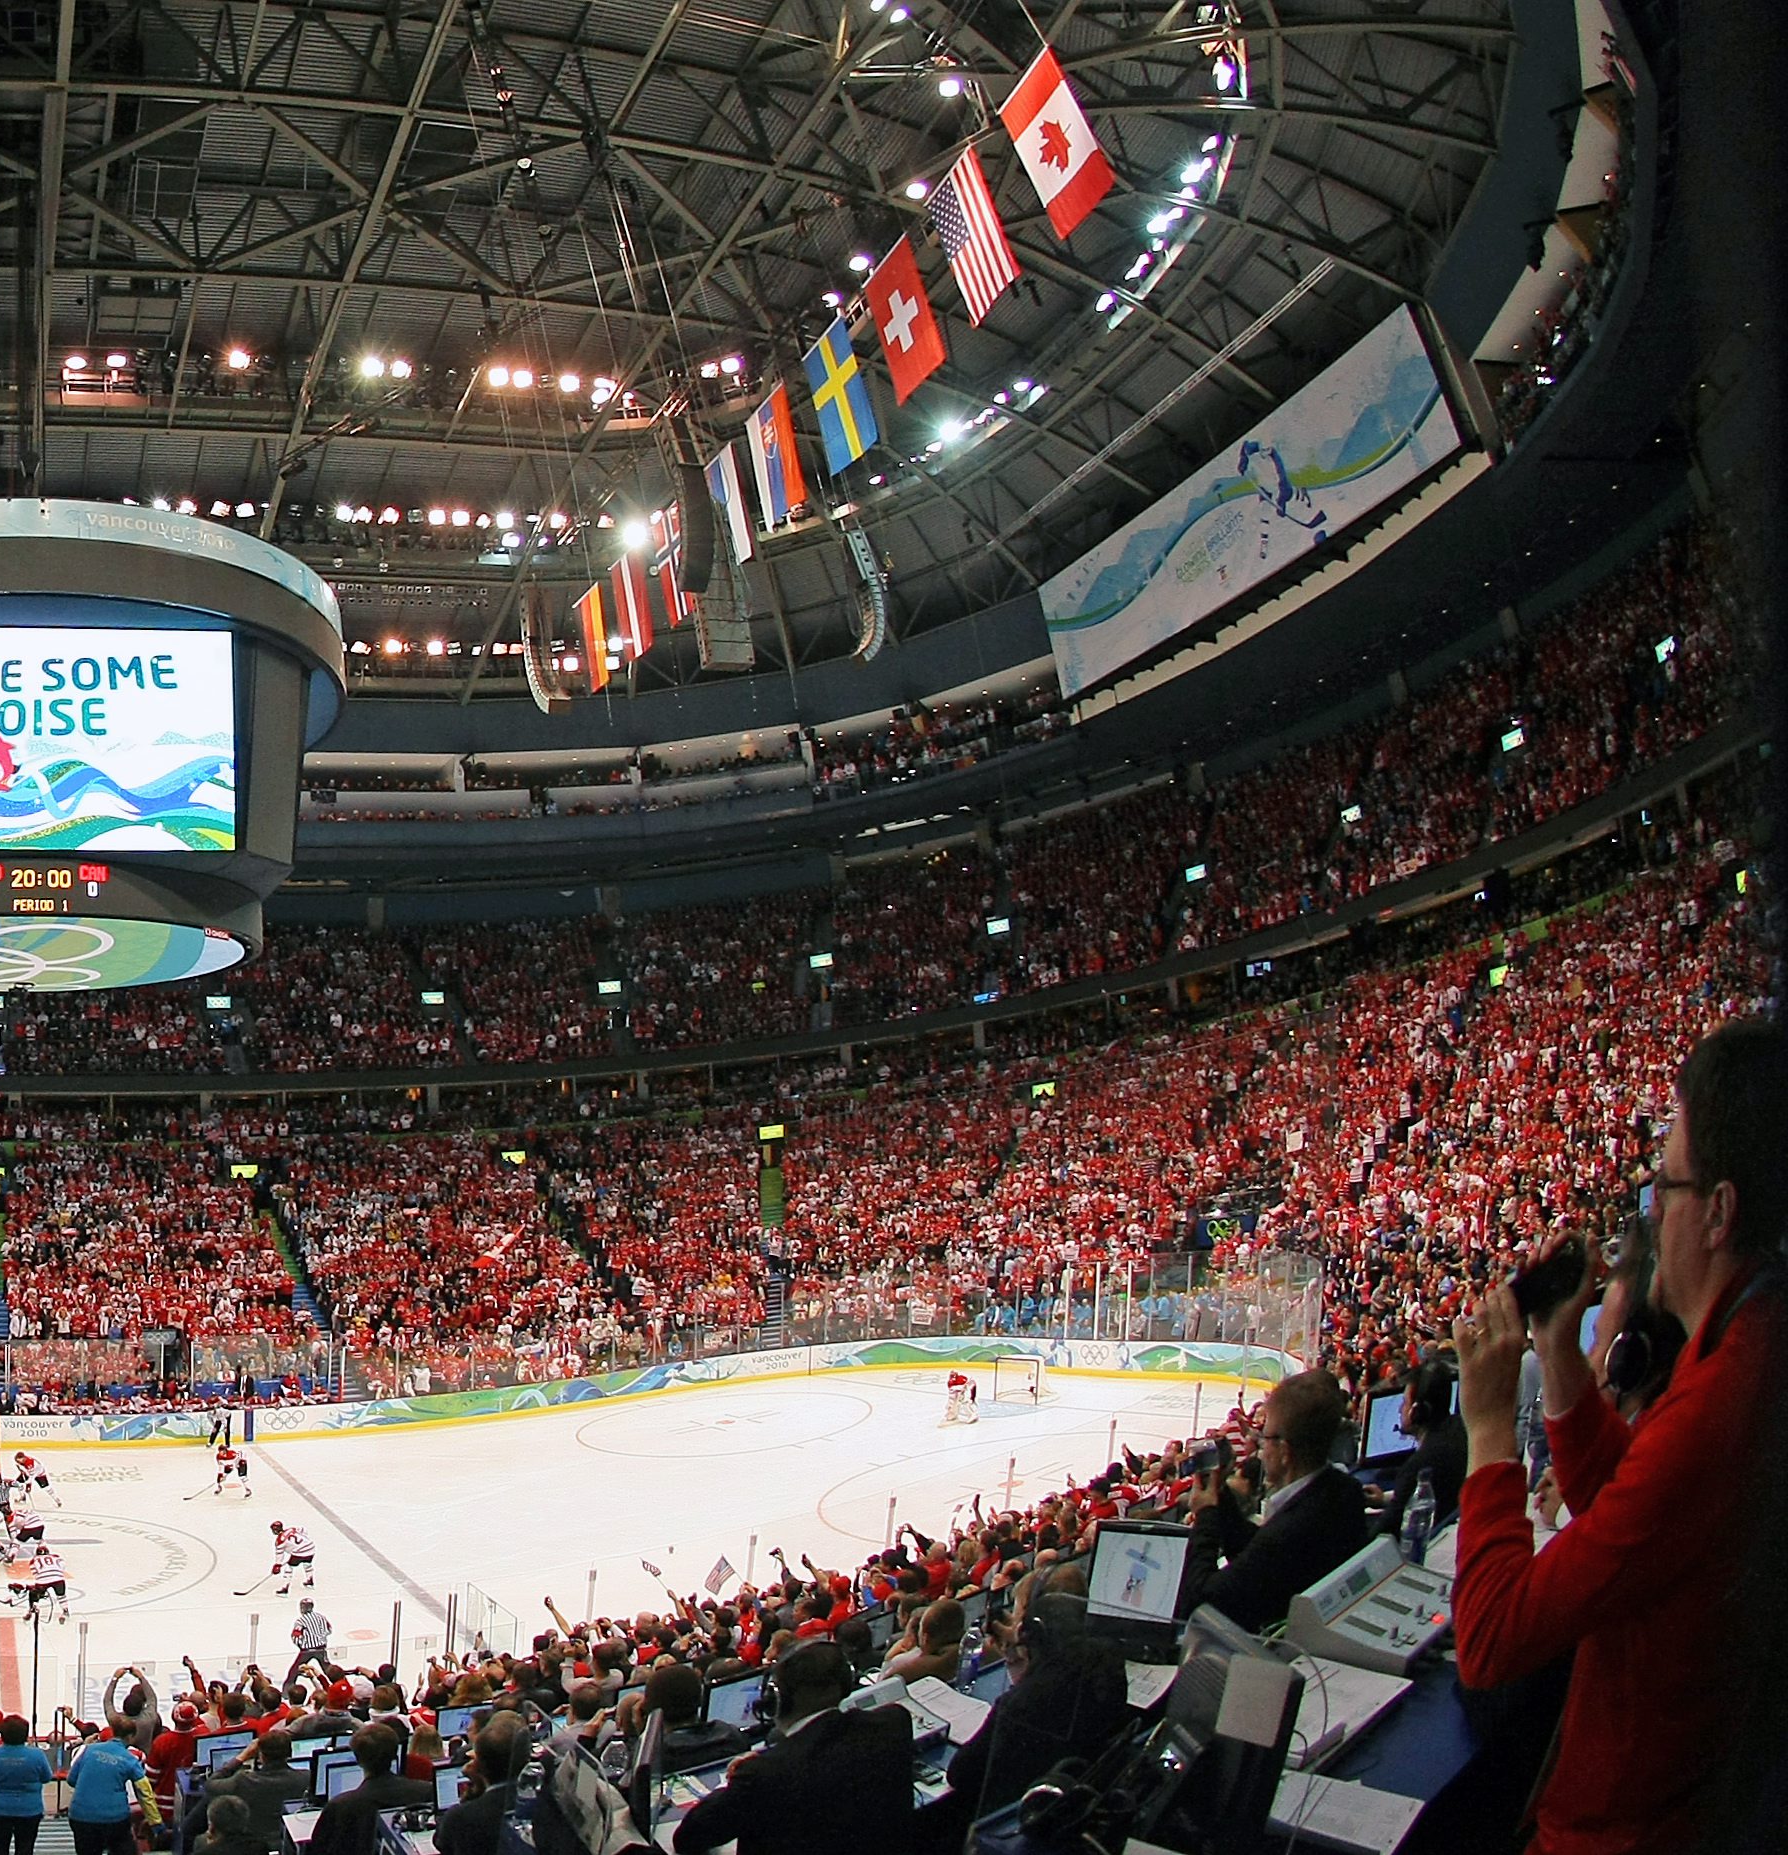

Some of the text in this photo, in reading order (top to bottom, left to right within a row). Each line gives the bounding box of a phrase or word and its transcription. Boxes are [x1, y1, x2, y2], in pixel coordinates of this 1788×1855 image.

[86, 512, 189, 538] vancouver
[41, 655, 178, 691] SOME
[11, 869, 72, 888] 20:00
[79, 864, 107, 881] CAN
[86, 881, 99, 897] 0
[13, 899, 68, 912] PERIOD 1
[752, 1351, 803, 1363] vancouver
[766, 1361, 789, 1370] 2010
[3, 1420, 64, 1428] vancouver
